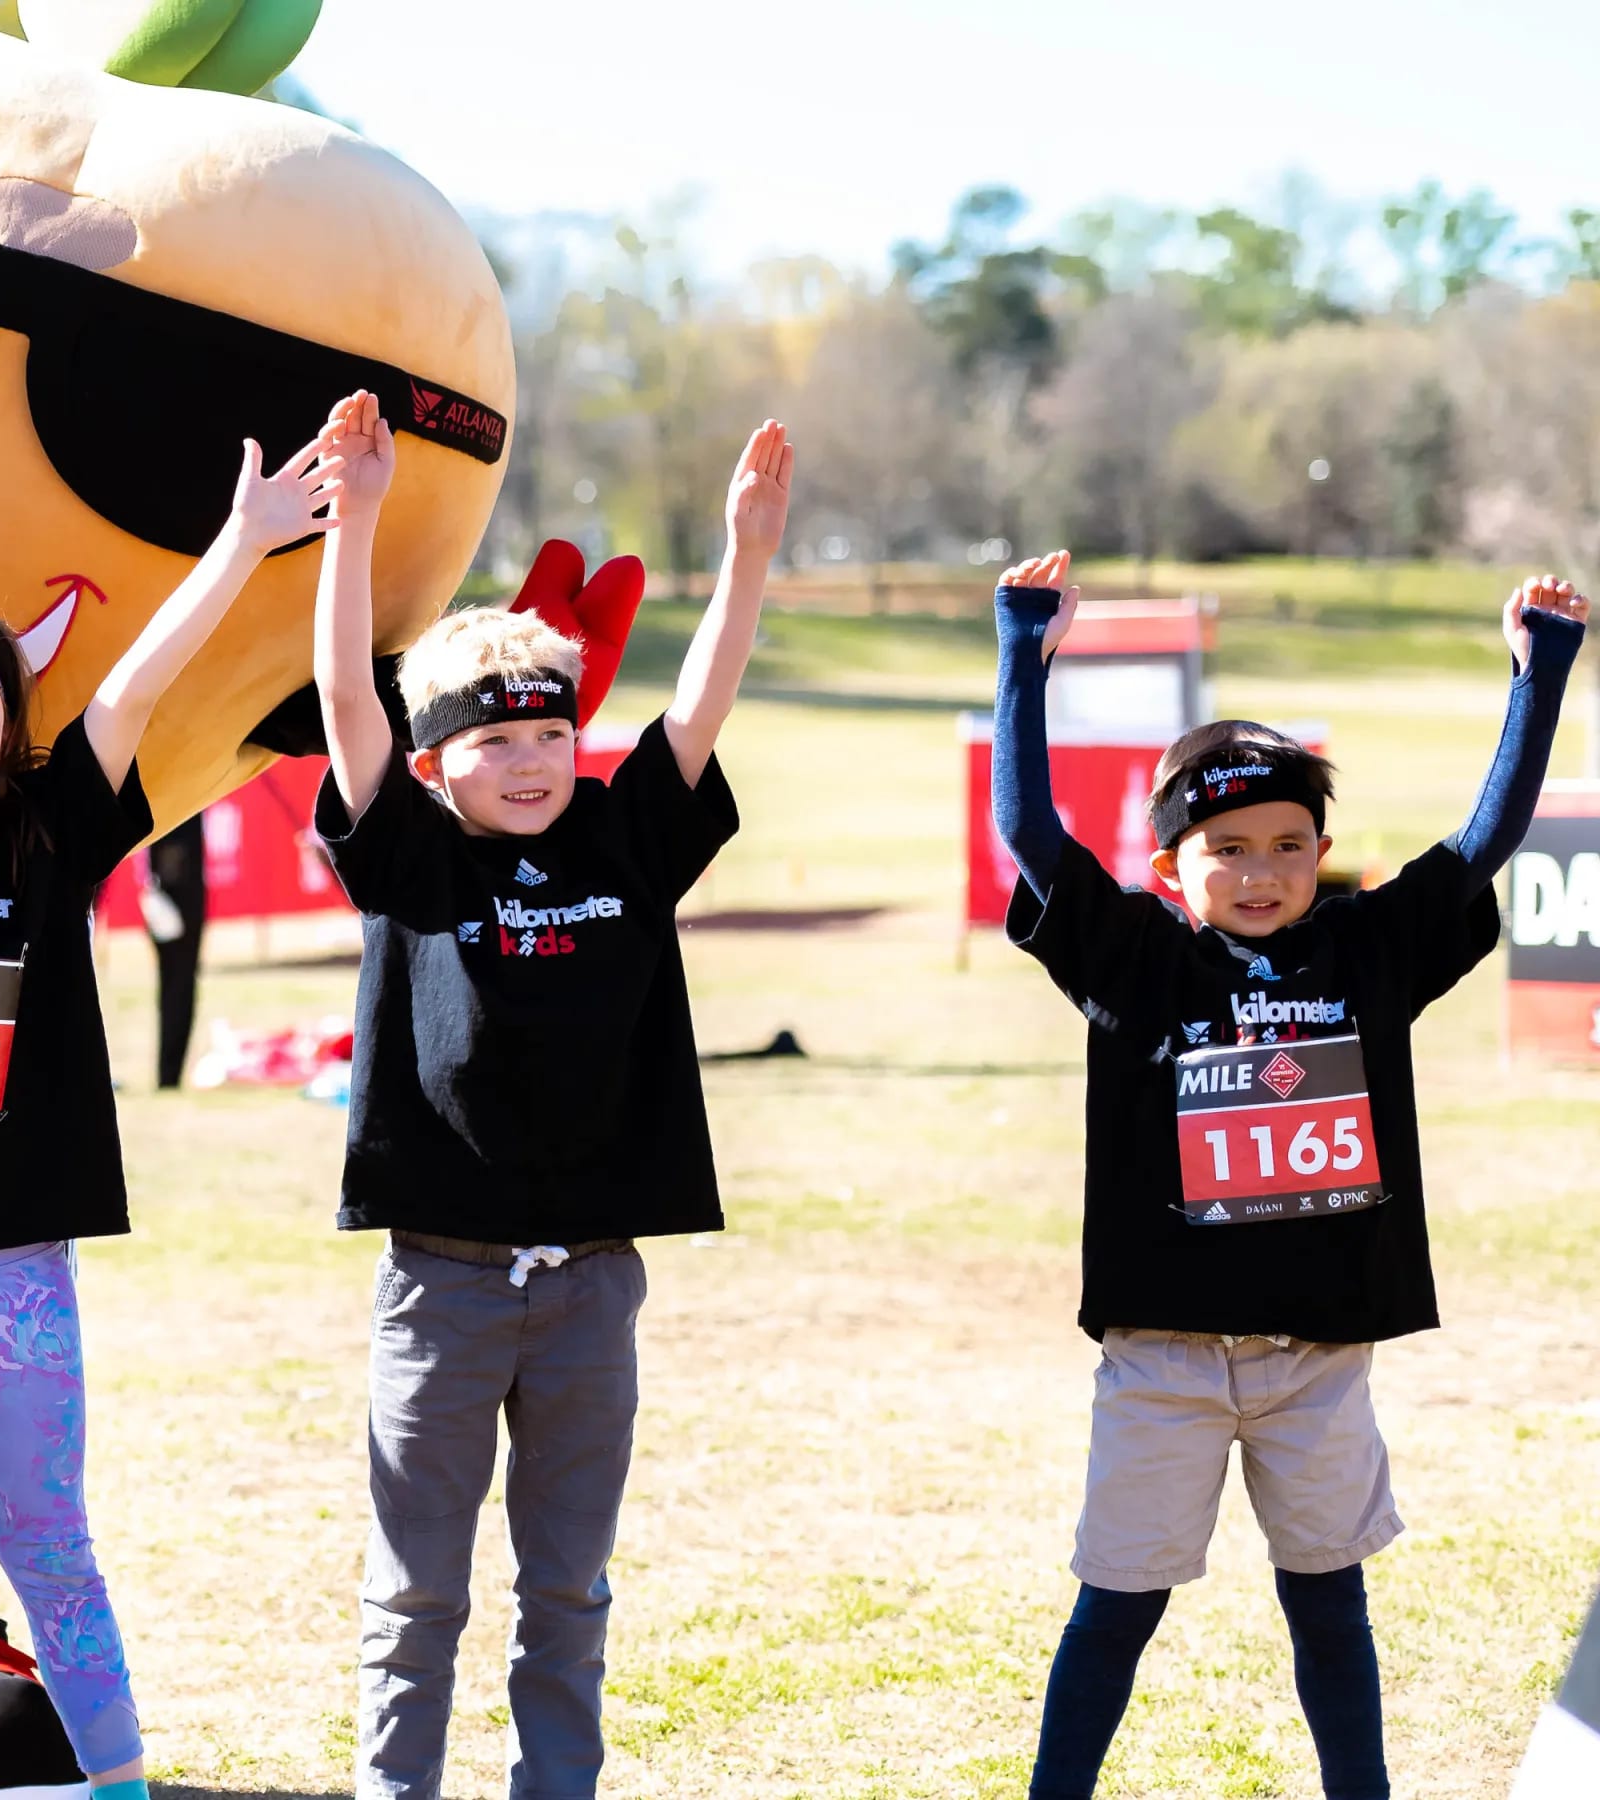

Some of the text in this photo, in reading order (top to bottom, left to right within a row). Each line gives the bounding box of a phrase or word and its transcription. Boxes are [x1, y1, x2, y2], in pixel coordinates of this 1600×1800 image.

[444, 401, 503, 441] ATLANTA
[1204, 763, 1273, 785] kilometer
[493, 895, 624, 929] kilometer
[1178, 1063, 1253, 1096] MILE
[1204, 1116, 1364, 1181] 1165
[1246, 1202, 1283, 1216] DASANI
[1342, 1190, 1369, 1206] PNC
[1203, 1212, 1231, 1221] adidas
